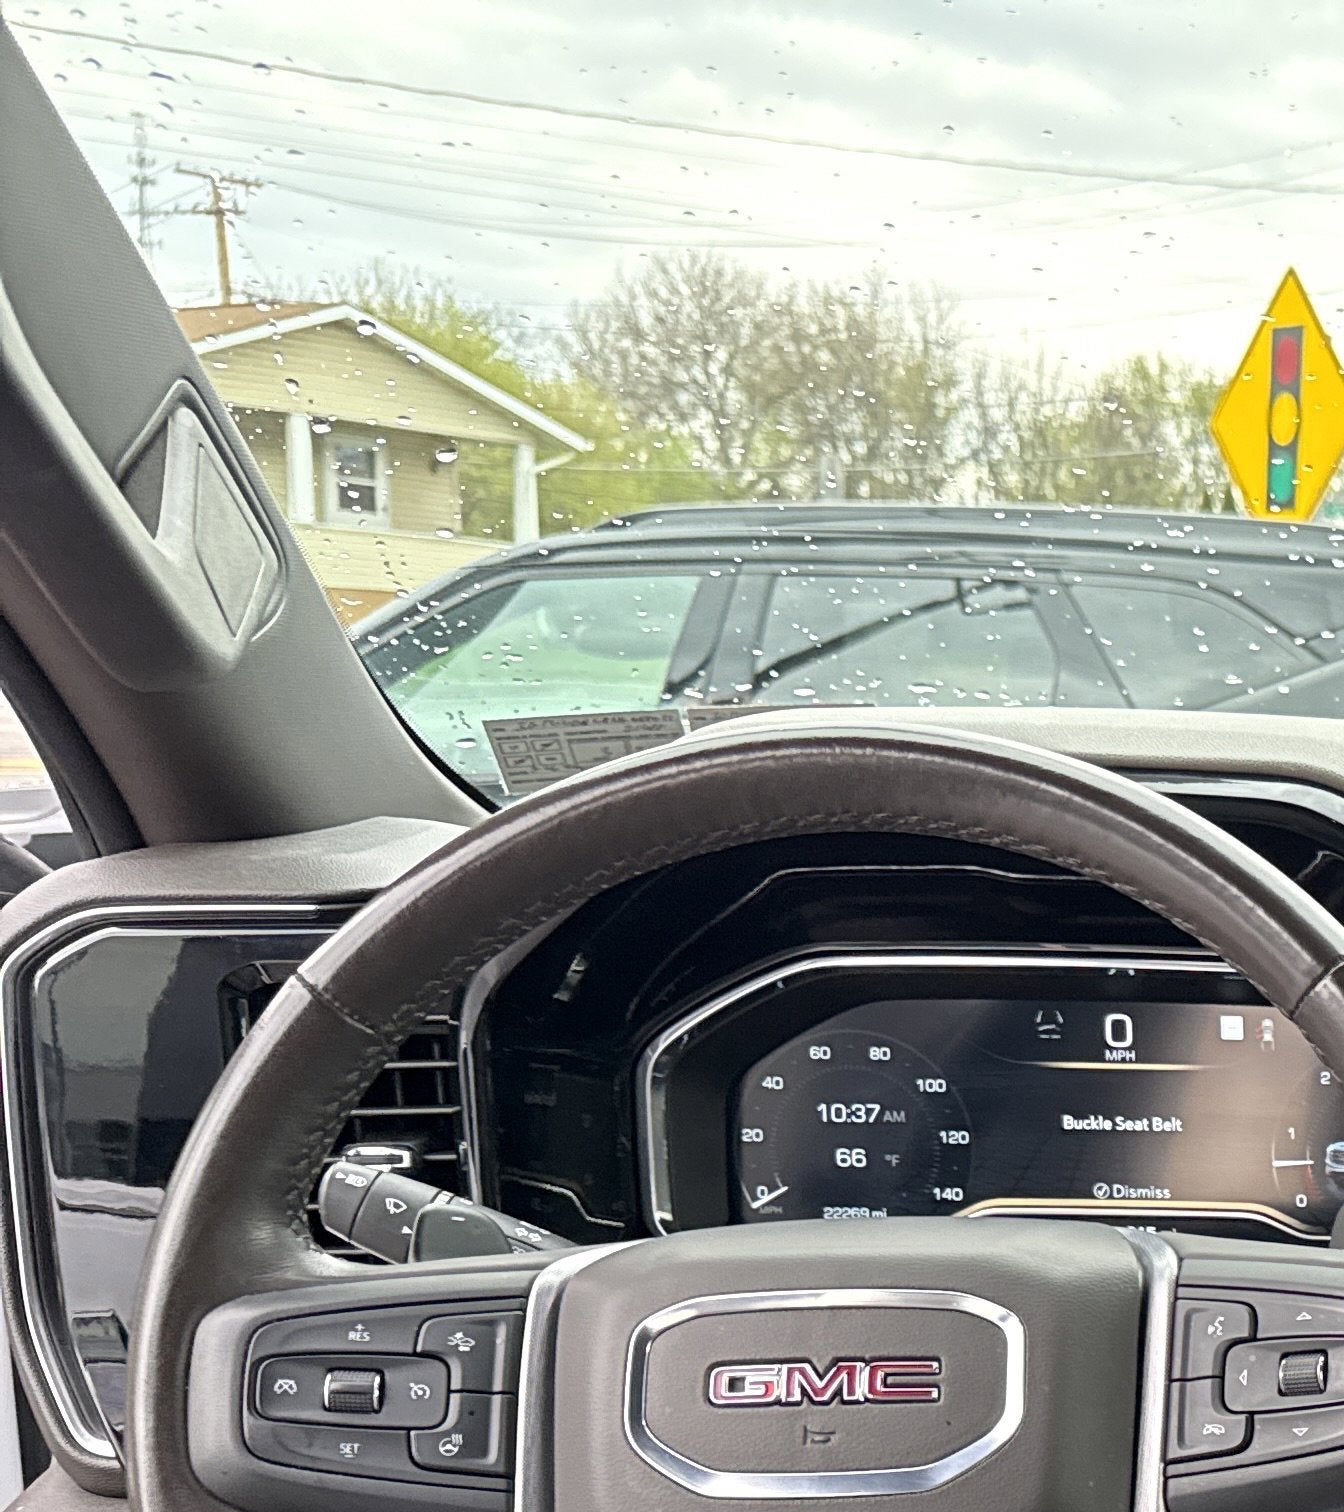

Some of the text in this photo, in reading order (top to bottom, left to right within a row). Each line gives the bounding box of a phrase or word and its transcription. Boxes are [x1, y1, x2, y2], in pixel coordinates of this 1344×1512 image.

[1104, 1012, 1133, 1048] 0
[809, 1046, 831, 1060] 60
[869, 1046, 891, 1061] 80
[1104, 1049, 1136, 1062] MPH
[762, 1076, 784, 1090] 40
[1320, 1071, 1331, 1085] 2
[916, 1078, 947, 1093] 100
[816, 1103, 907, 1123] 10:37 AM
[1061, 1114, 1183, 1132] Buckle Seat Belt
[741, 1128, 764, 1142] 20
[939, 1130, 970, 1145] 120
[1287, 1127, 1296, 1140] 1
[834, 1148, 867, 1168] 66
[756, 1185, 769, 1199] 0
[932, 1187, 964, 1201] 140
[1112, 1183, 1172, 1200] Dismiss
[1295, 1194, 1308, 1208] 0
[347, 1330, 371, 1342] RES
[708, 1360, 941, 1406] GMC
[339, 1442, 361, 1454] SET
